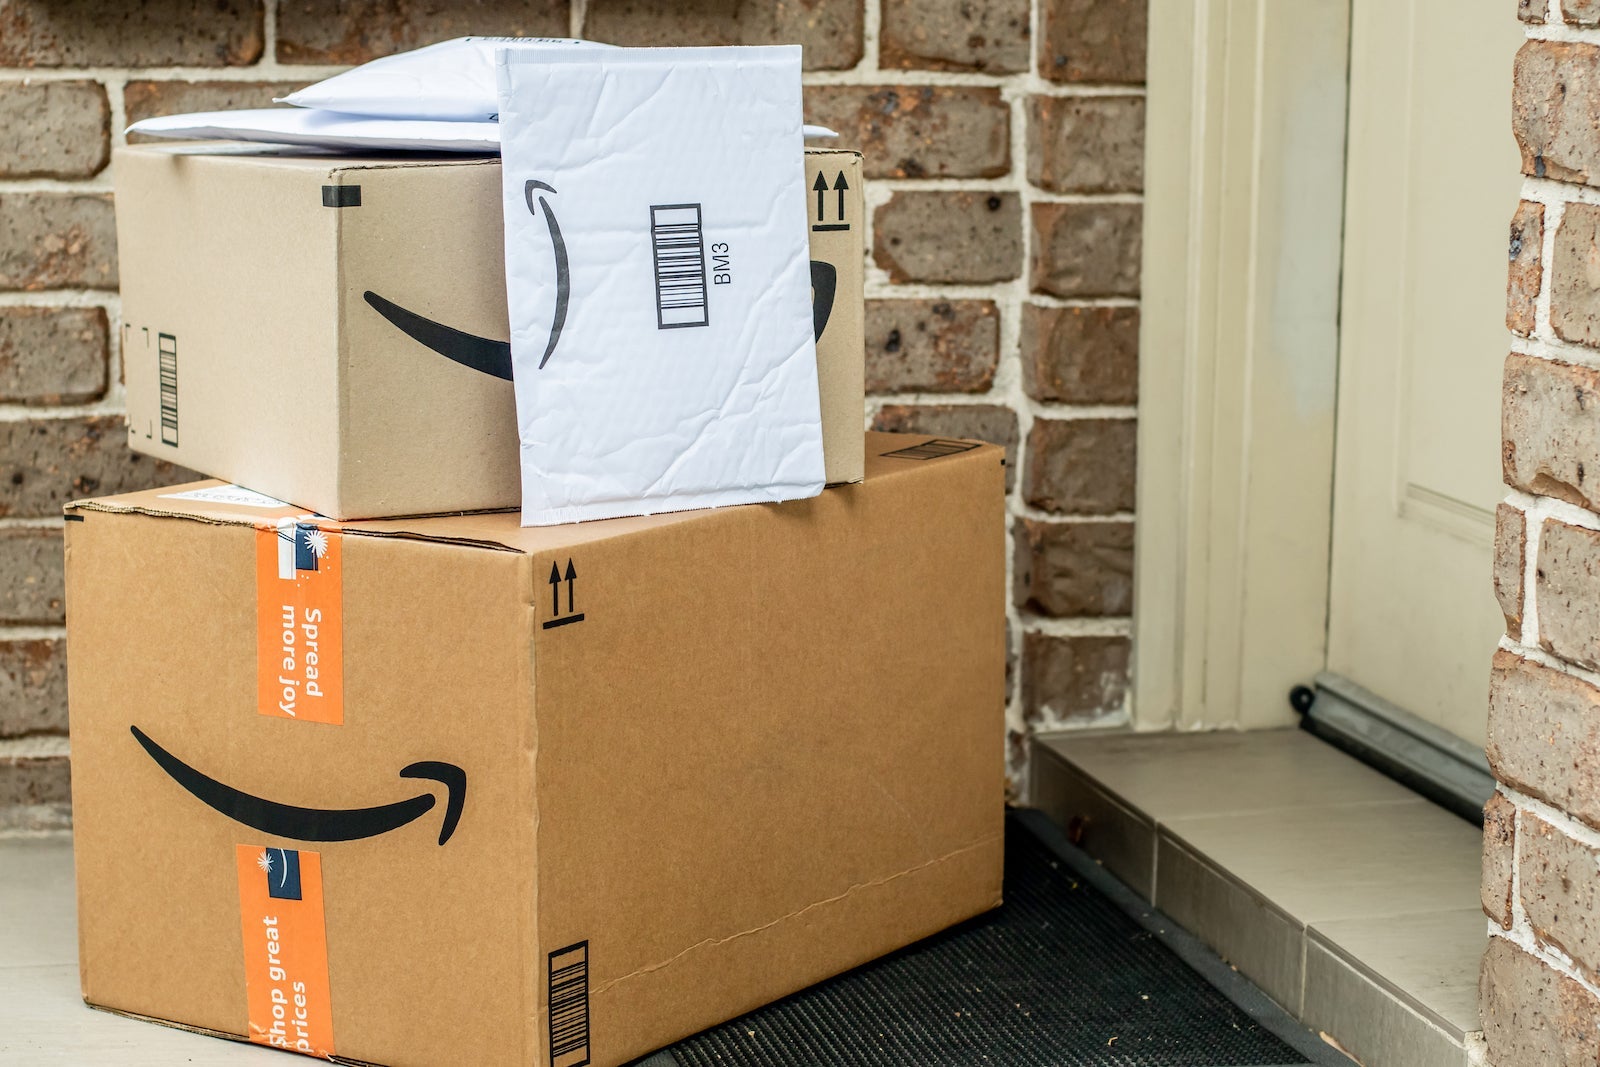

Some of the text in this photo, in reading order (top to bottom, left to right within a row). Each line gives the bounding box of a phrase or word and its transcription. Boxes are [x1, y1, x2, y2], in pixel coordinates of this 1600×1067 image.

[711, 242, 731, 285] BM3
[278, 605, 300, 717] more joy
[302, 608, 324, 697] Spread
[263, 915, 289, 1048] Shop great
[291, 981, 314, 1053] prices
